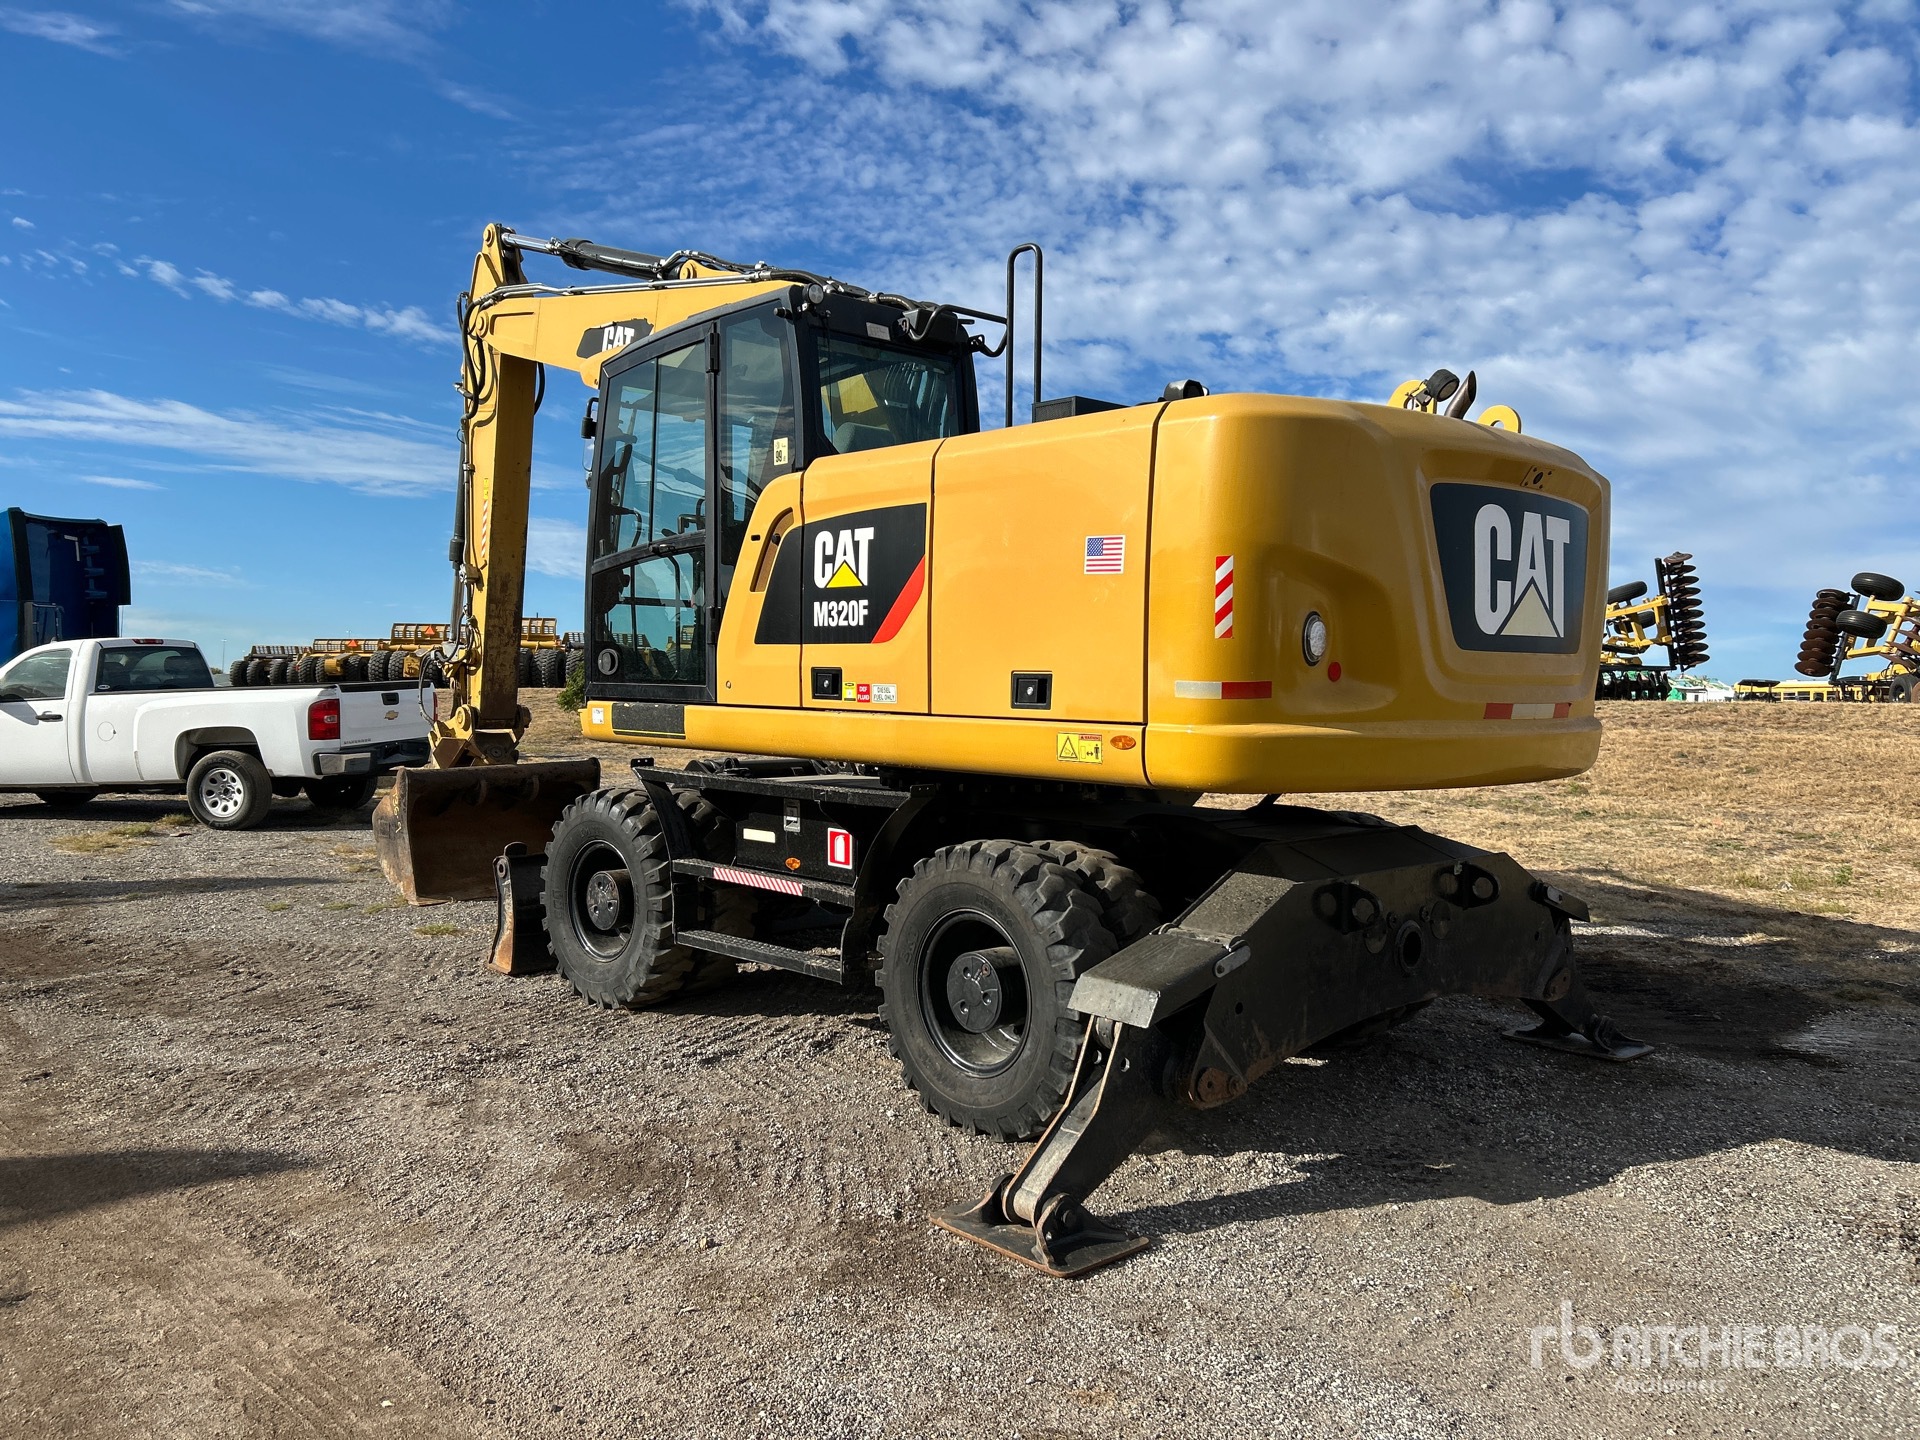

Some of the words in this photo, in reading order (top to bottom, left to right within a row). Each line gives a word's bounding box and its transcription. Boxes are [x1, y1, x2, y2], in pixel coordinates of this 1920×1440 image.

[602, 325, 635, 352] CAT
[814, 527, 875, 589] CAT
[1474, 503, 1570, 638] CAT
[813, 599, 869, 627] M320F
